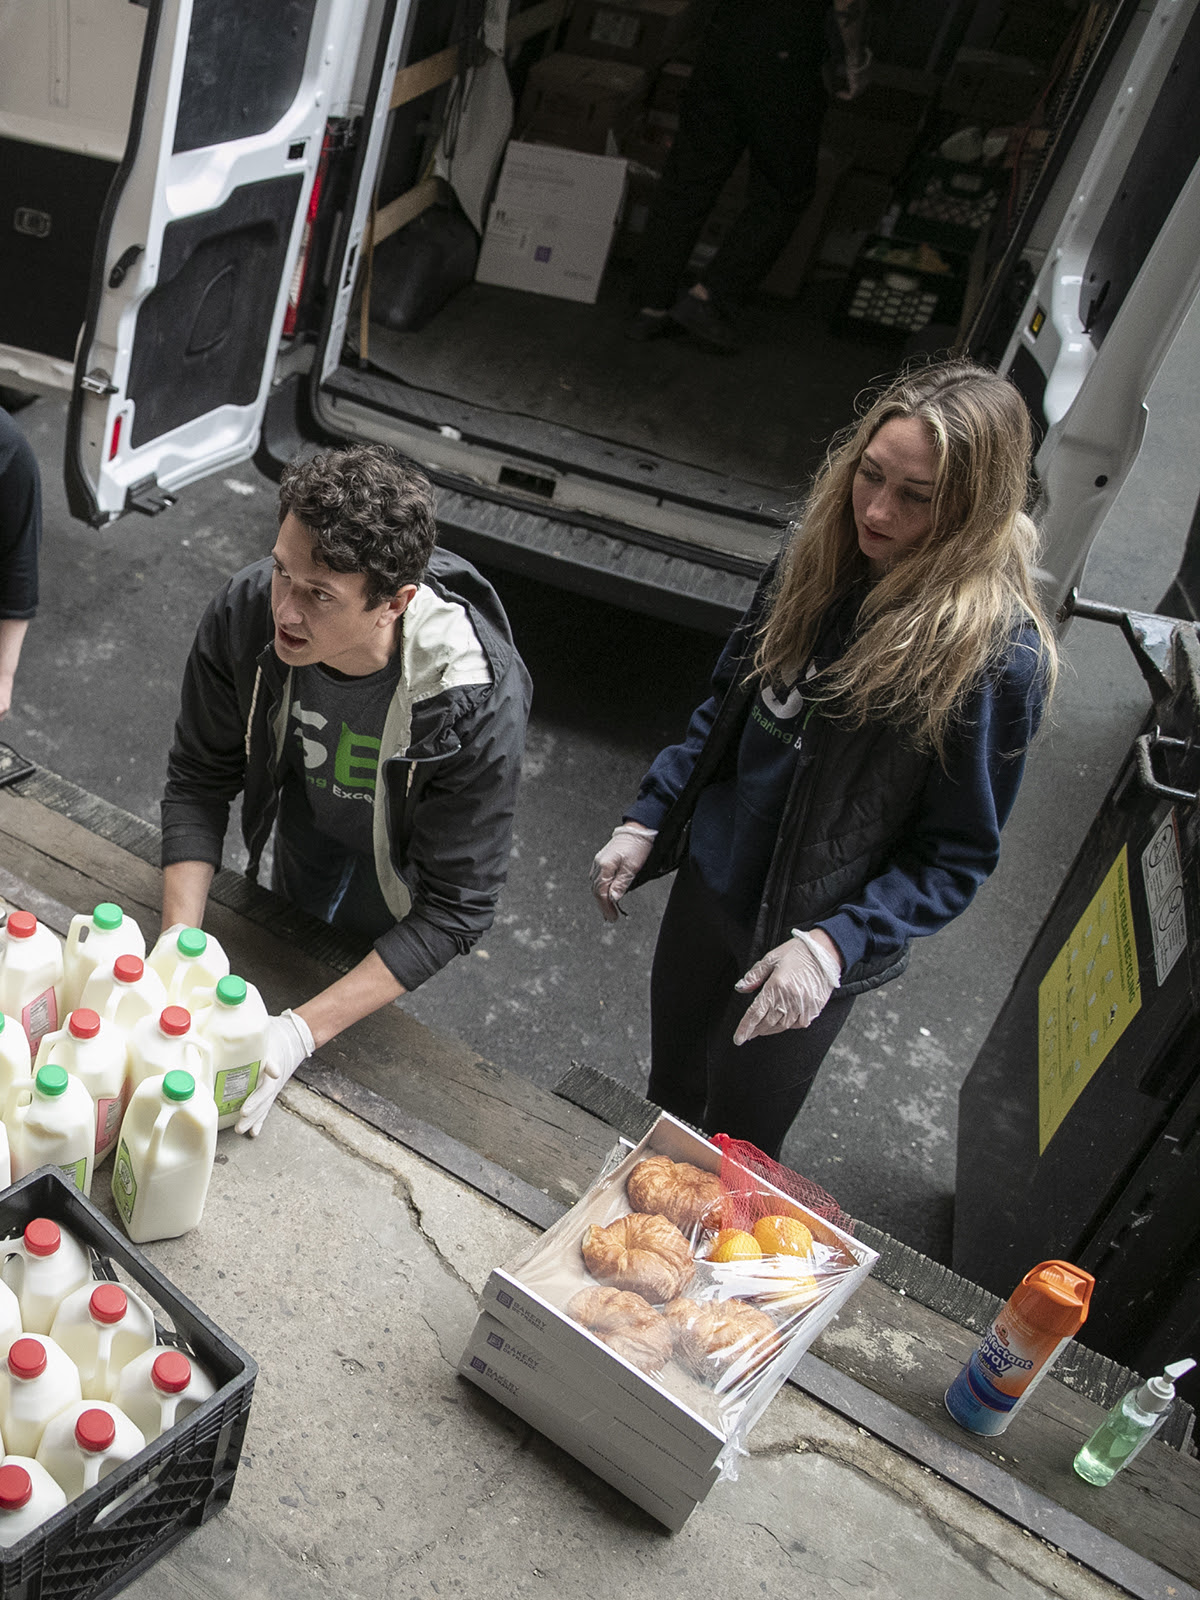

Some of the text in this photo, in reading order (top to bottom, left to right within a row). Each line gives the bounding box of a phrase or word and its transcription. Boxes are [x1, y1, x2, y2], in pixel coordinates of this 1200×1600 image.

[751, 705, 794, 744] sharing
[332, 784, 376, 805] Exce
[1124, 940, 1136, 1004] RECYCLING
[513, 1302, 547, 1328] BAKERY
[502, 1347, 510, 1355] DE
[504, 1343, 540, 1366] BAKERY
[486, 1367, 520, 1390] BAKERY
